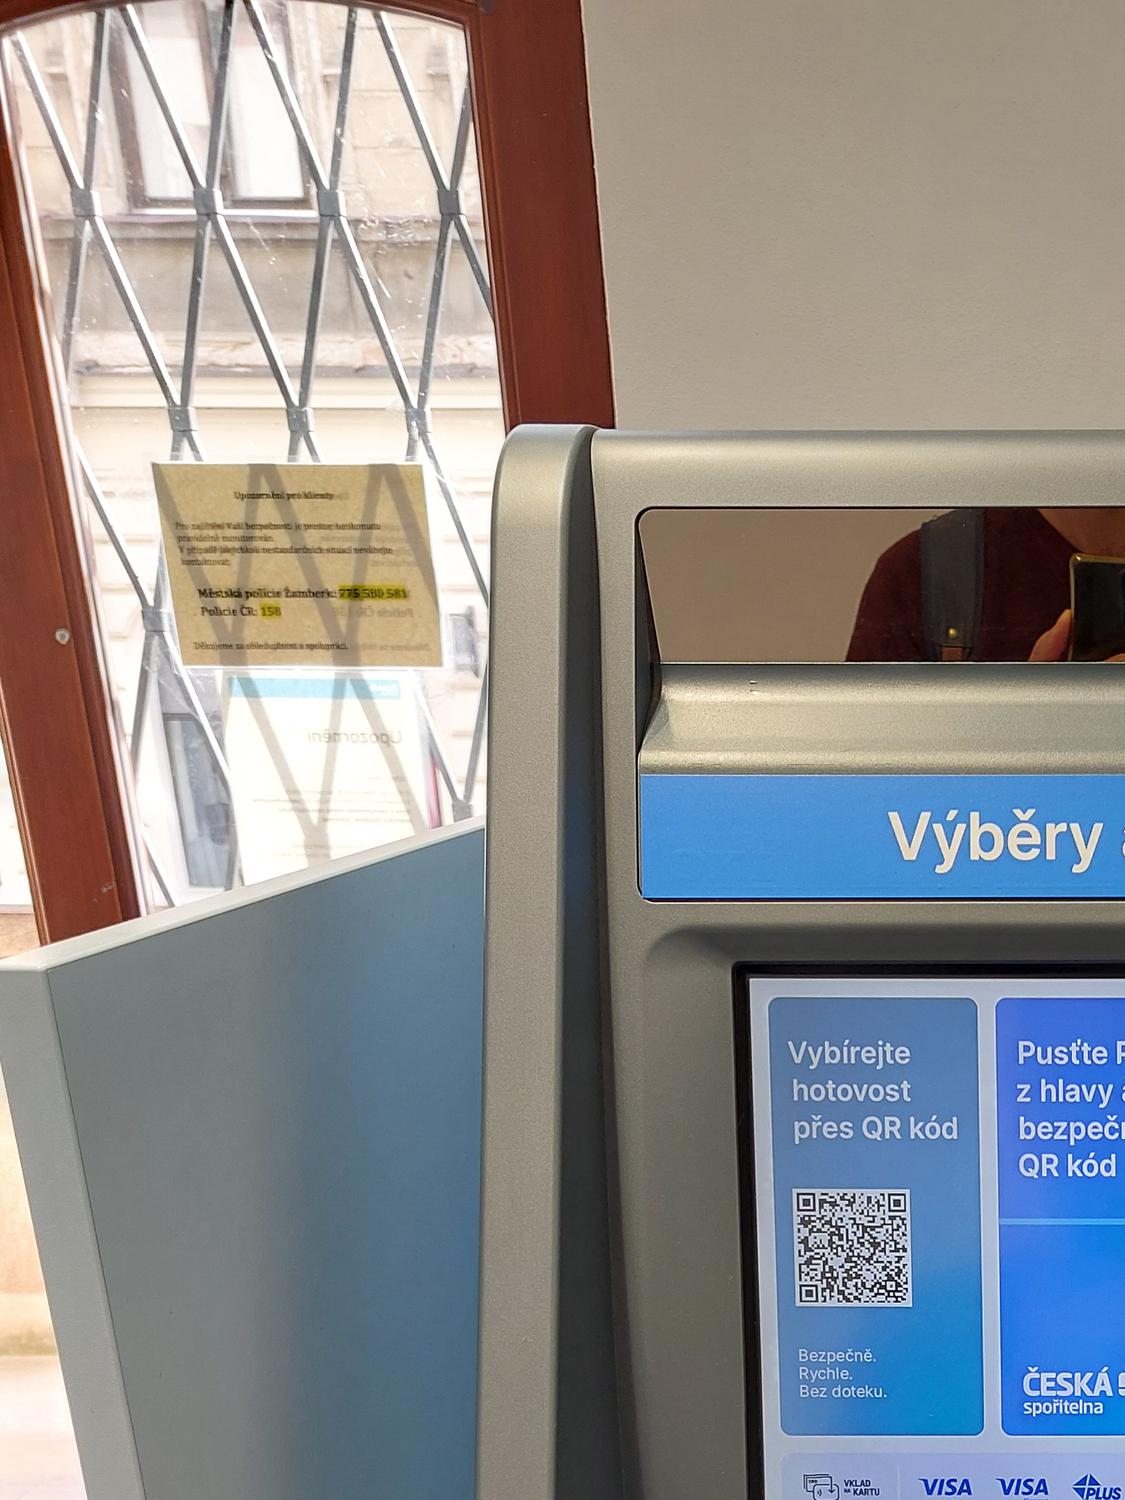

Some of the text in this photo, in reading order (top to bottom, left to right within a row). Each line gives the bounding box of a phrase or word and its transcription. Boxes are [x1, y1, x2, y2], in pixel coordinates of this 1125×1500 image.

[198, 588, 243, 598] Městská
[244, 588, 282, 601] policie
[200, 606, 238, 617] Policie
[240, 604, 258, 617] ČR:
[887, 807, 1103, 874] Výběry
[787, 1040, 911, 1070] Vybírejte
[1017, 1040, 1108, 1065] Pusťte
[793, 1079, 911, 1102] hotovost
[1016, 1084, 1032, 1102] z
[1040, 1079, 1113, 1108] hlavy
[794, 1114, 958, 1144] přes QR kód
[1018, 1154, 1117, 1179] QR kód
[799, 1348, 877, 1367] Bezpečně.
[799, 1367, 853, 1383] Rychle.
[1022, 1366, 1113, 1398] ČESKÁ
[800, 1385, 888, 1399] Bez doteku.
[1023, 1398, 1104, 1417] spořitelna
[843, 1480, 871, 1488] VKLAD
[852, 1488, 880, 1496] KARTU
[918, 1478, 973, 1496] VISA
[995, 1478, 1049, 1496] VISA
[1085, 1487, 1122, 1500] PLUS
